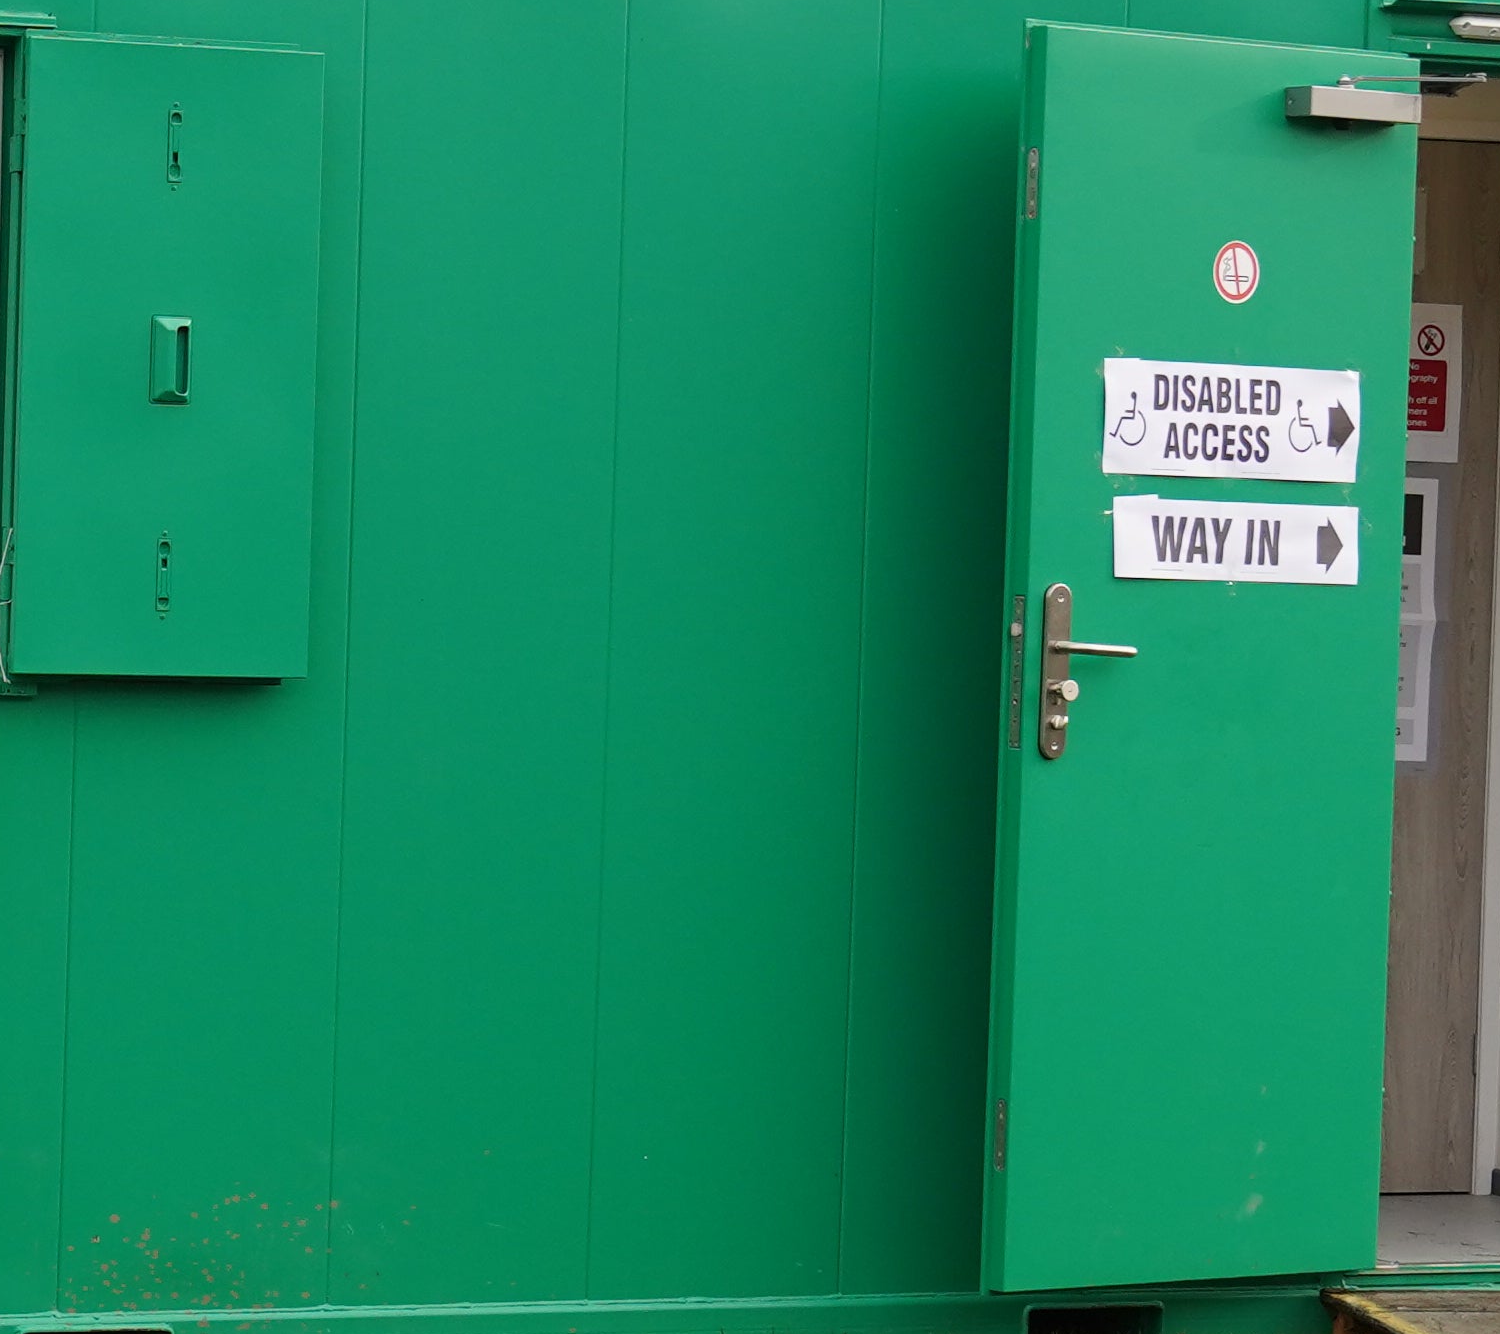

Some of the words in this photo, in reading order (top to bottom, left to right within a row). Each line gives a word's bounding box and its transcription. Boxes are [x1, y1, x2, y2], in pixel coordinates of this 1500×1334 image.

[1153, 373, 1281, 416] DISABLED
[1408, 374, 1439, 384] graphy
[1163, 422, 1270, 463] ACCESS
[1151, 515, 1233, 565] WAY
[1244, 519, 1281, 566] IN
